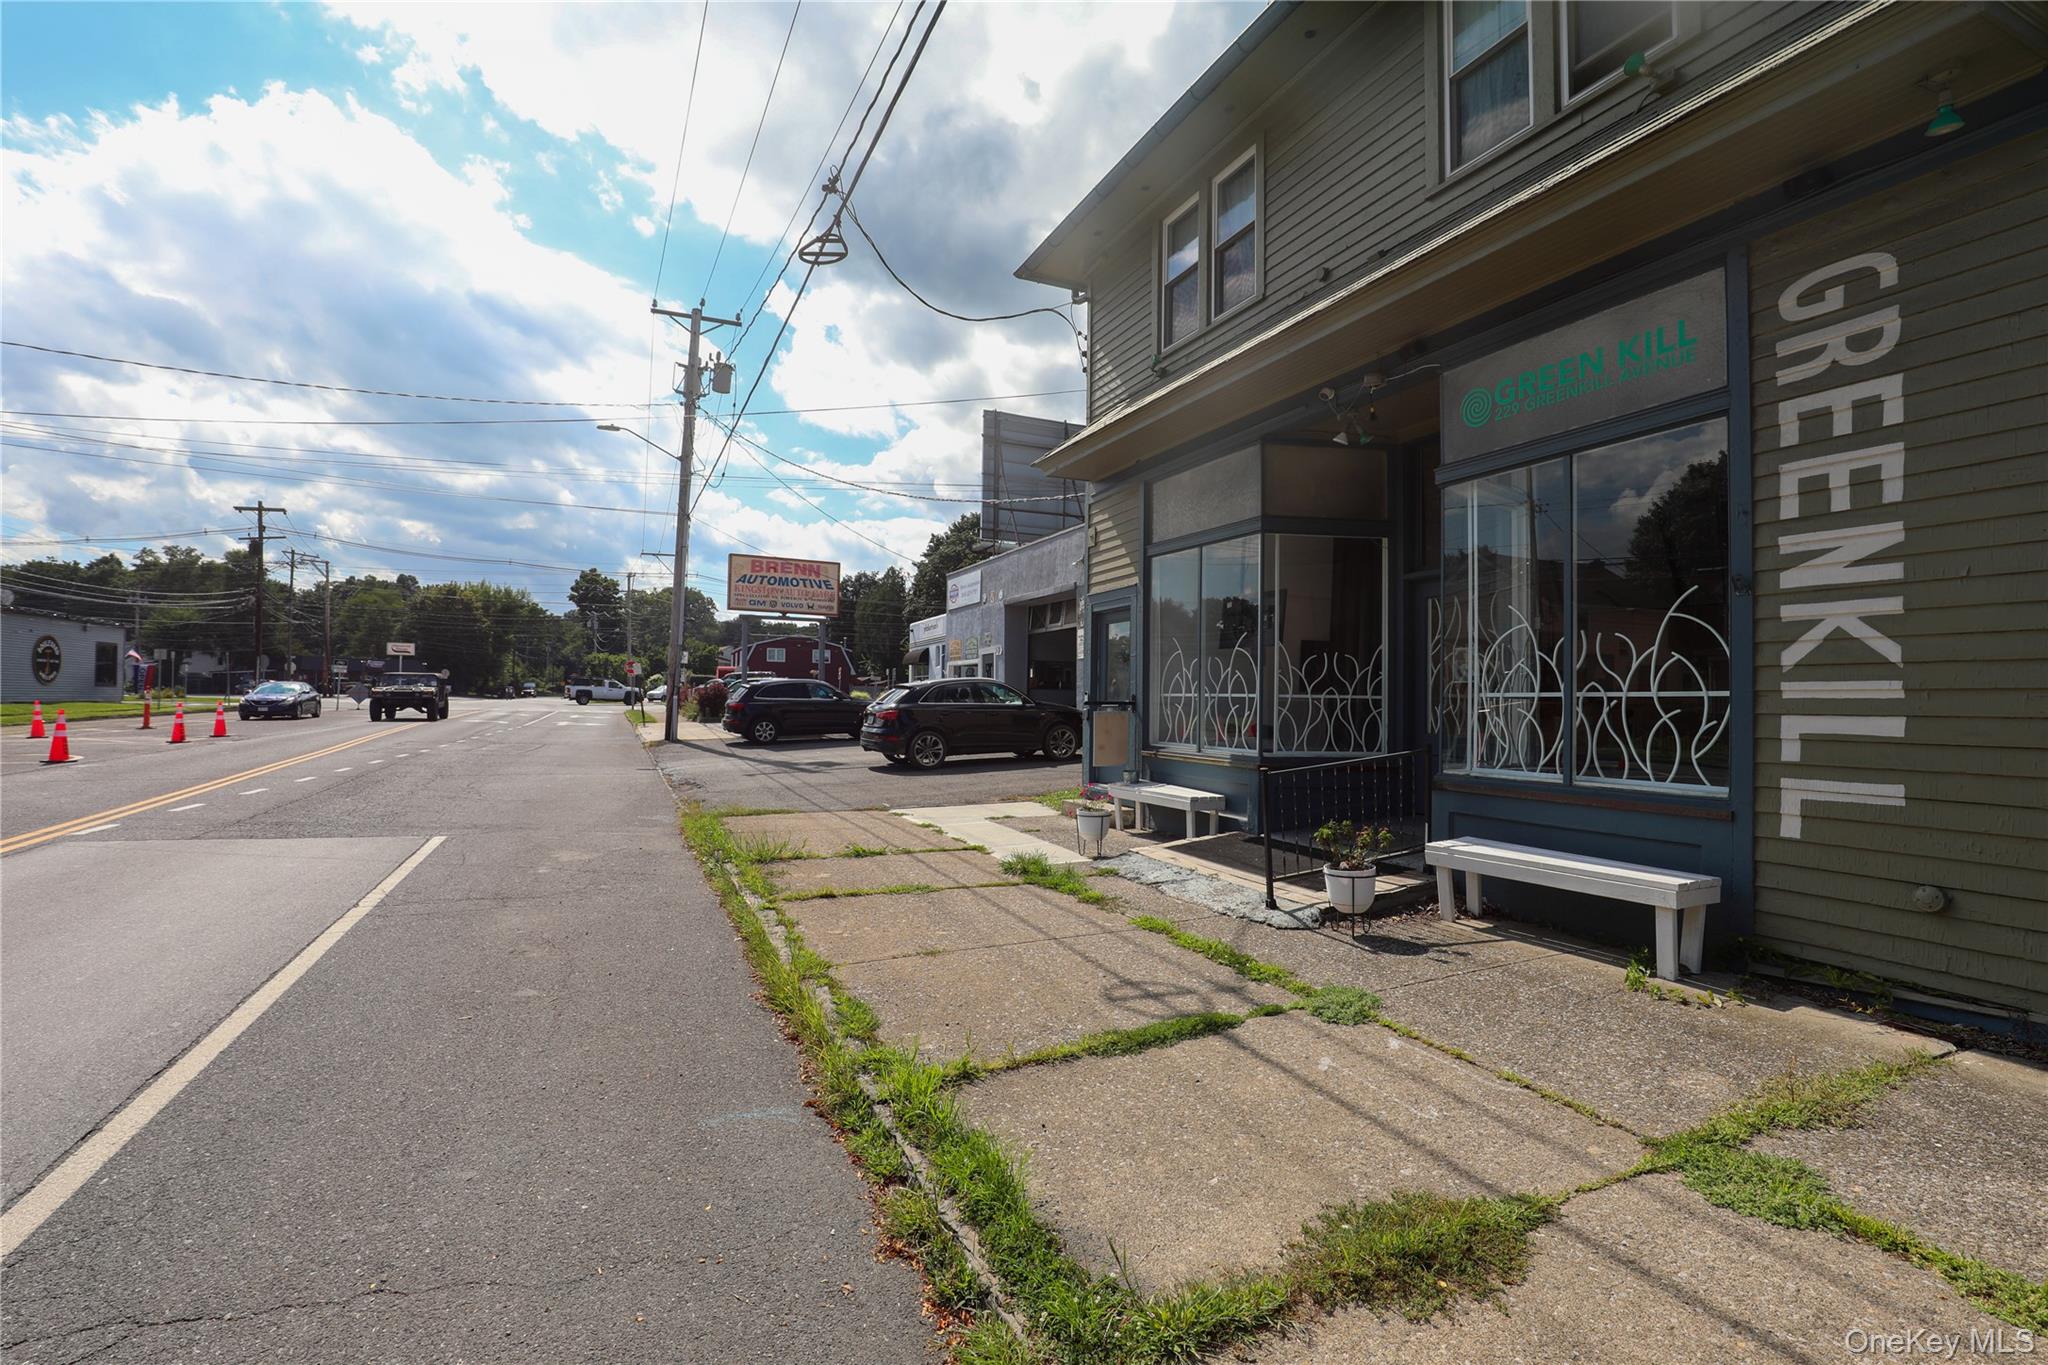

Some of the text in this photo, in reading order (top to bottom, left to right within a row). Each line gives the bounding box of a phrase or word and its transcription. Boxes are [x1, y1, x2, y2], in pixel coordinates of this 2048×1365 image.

[1495, 319, 1697, 404] GREEN KILL
[1495, 402, 1520, 421] 229
[1619, 346, 1697, 383] AVENUE
[751, 559, 821, 578] BRENN
[1775, 251, 1907, 840] GREENKILL
[735, 574, 834, 590] AUTOMOTIVE
[749, 599, 766, 607] GM
